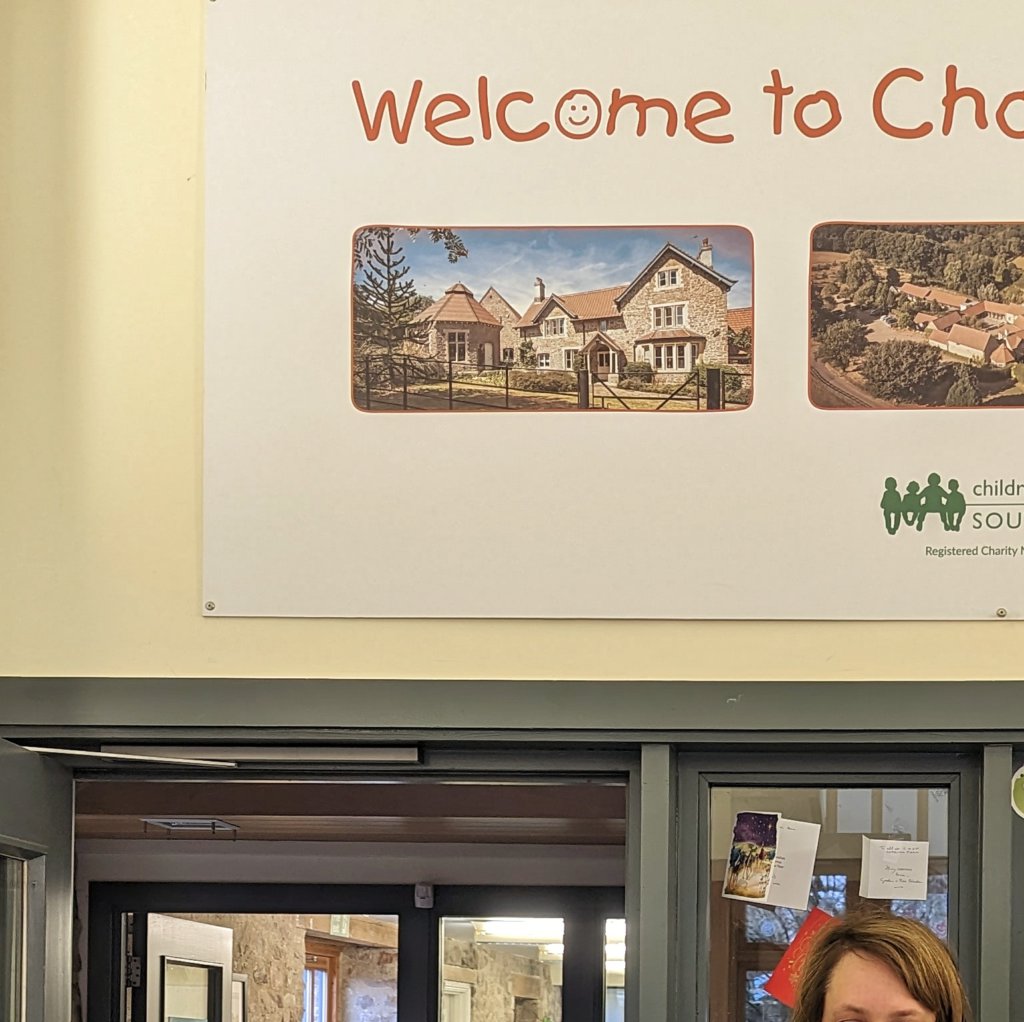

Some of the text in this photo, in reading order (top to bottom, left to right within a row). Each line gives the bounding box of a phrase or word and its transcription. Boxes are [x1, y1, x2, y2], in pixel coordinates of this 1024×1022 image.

[352, 76, 734, 146] Welcome
[763, 69, 842, 138] to
[925, 546, 979, 557] Registered
[981, 545, 1018, 557] Charity
